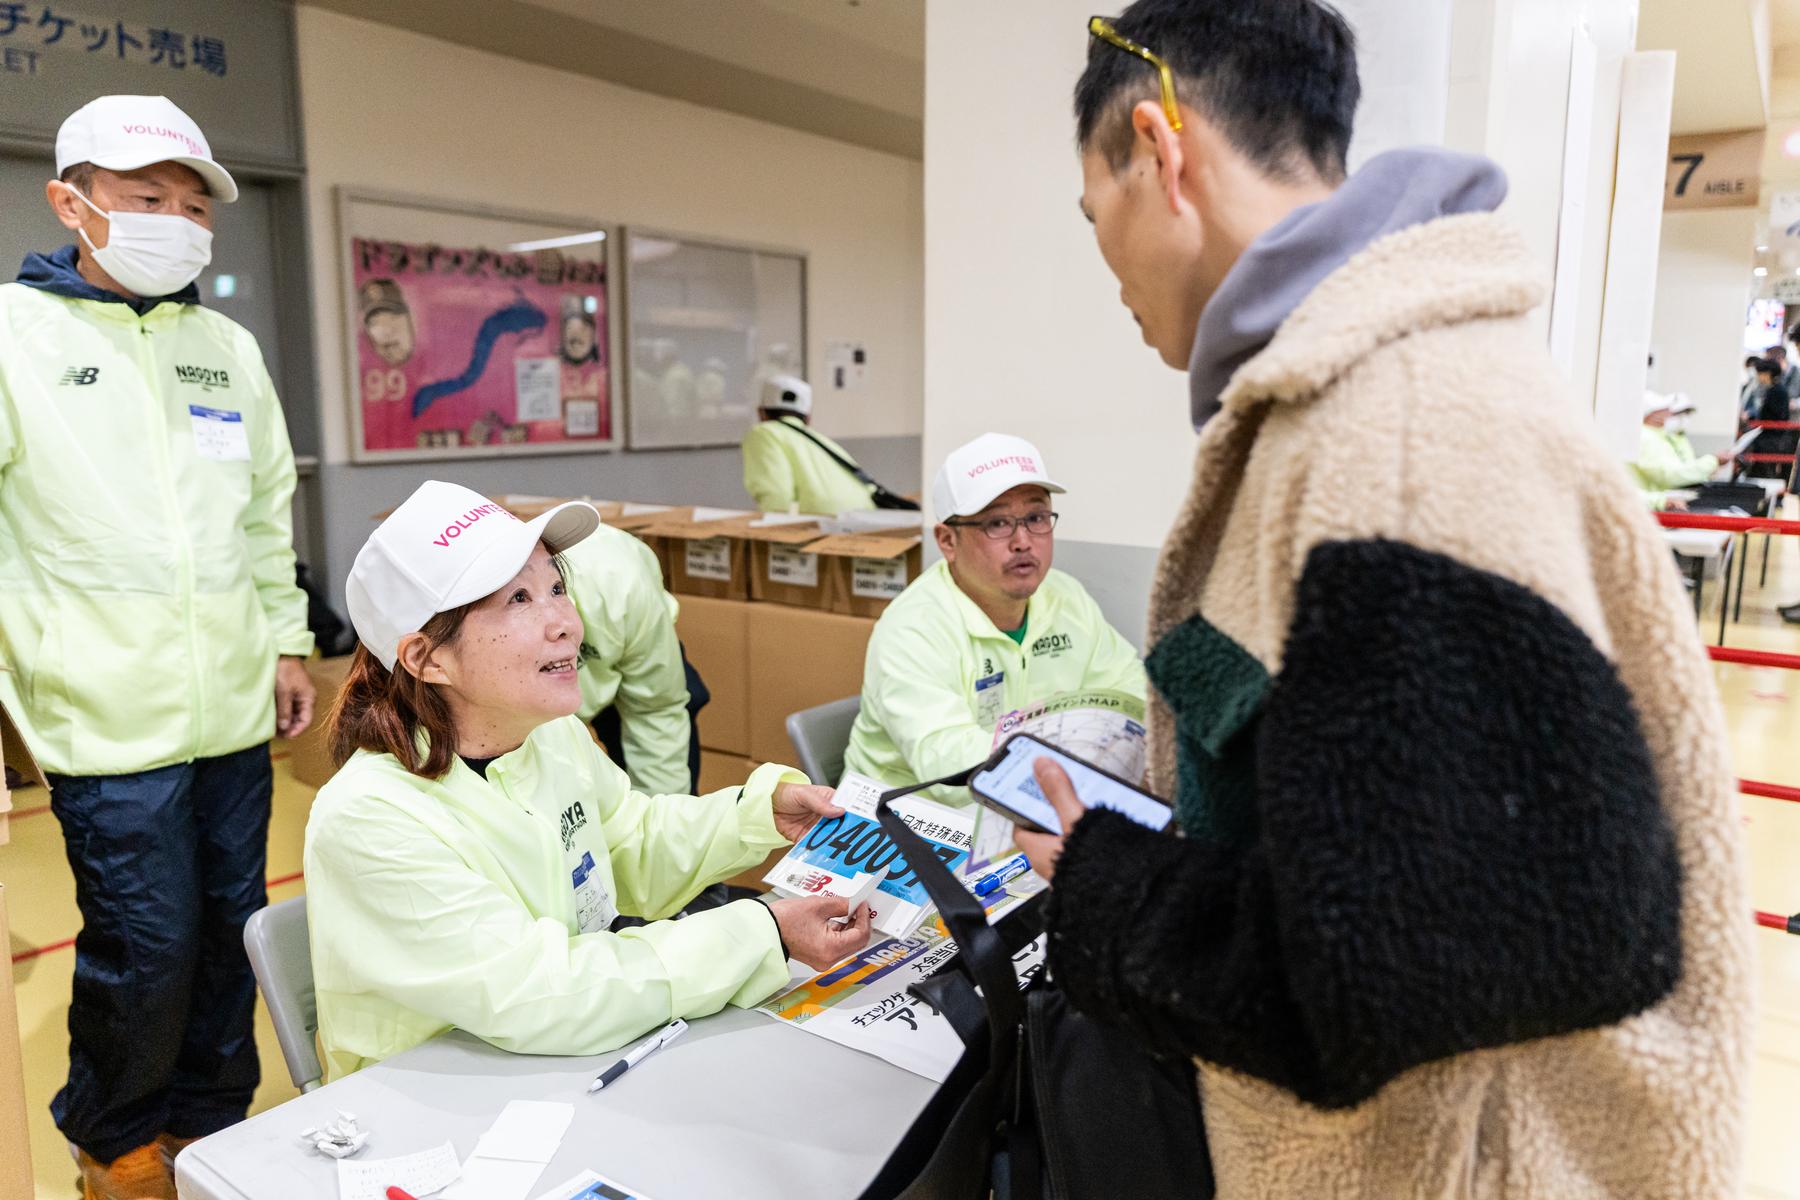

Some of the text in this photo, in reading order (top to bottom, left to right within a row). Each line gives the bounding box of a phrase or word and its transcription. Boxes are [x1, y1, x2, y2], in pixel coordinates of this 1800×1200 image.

[0, 47, 38, 73] ET
[1703, 179, 1744, 194] AISLE
[175, 364, 229, 383] NAGOYA
[968, 455, 1034, 478] VOLUNTEER
[851, 990, 913, 1027] チェックゲ
